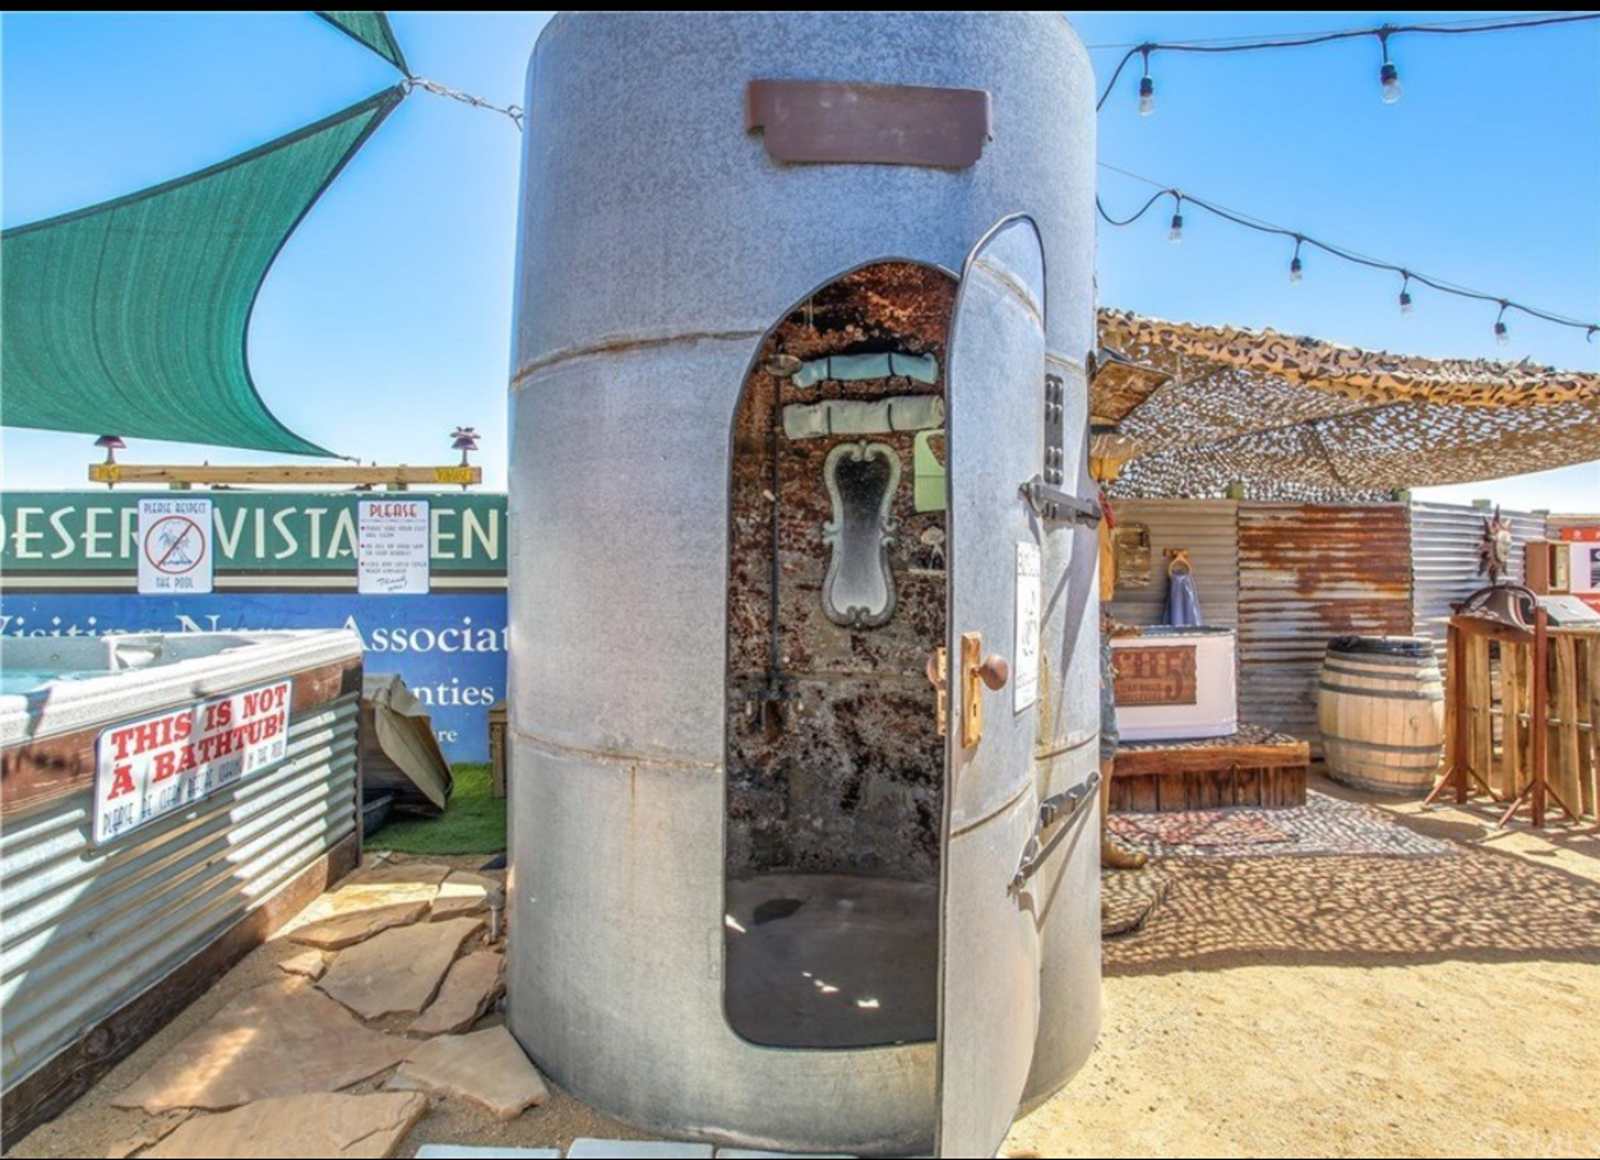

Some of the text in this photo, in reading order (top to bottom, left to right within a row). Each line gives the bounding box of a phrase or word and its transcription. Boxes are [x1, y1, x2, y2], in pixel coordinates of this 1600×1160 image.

[0, 506, 138, 559] ESER
[213, 507, 358, 560] VISTA
[370, 504, 417, 518] PLEASE
[412, 677, 494, 706] nties
[111, 684, 287, 760] THIS IS NOT
[107, 764, 135, 800] A
[152, 710, 285, 783] BATHTUB!
